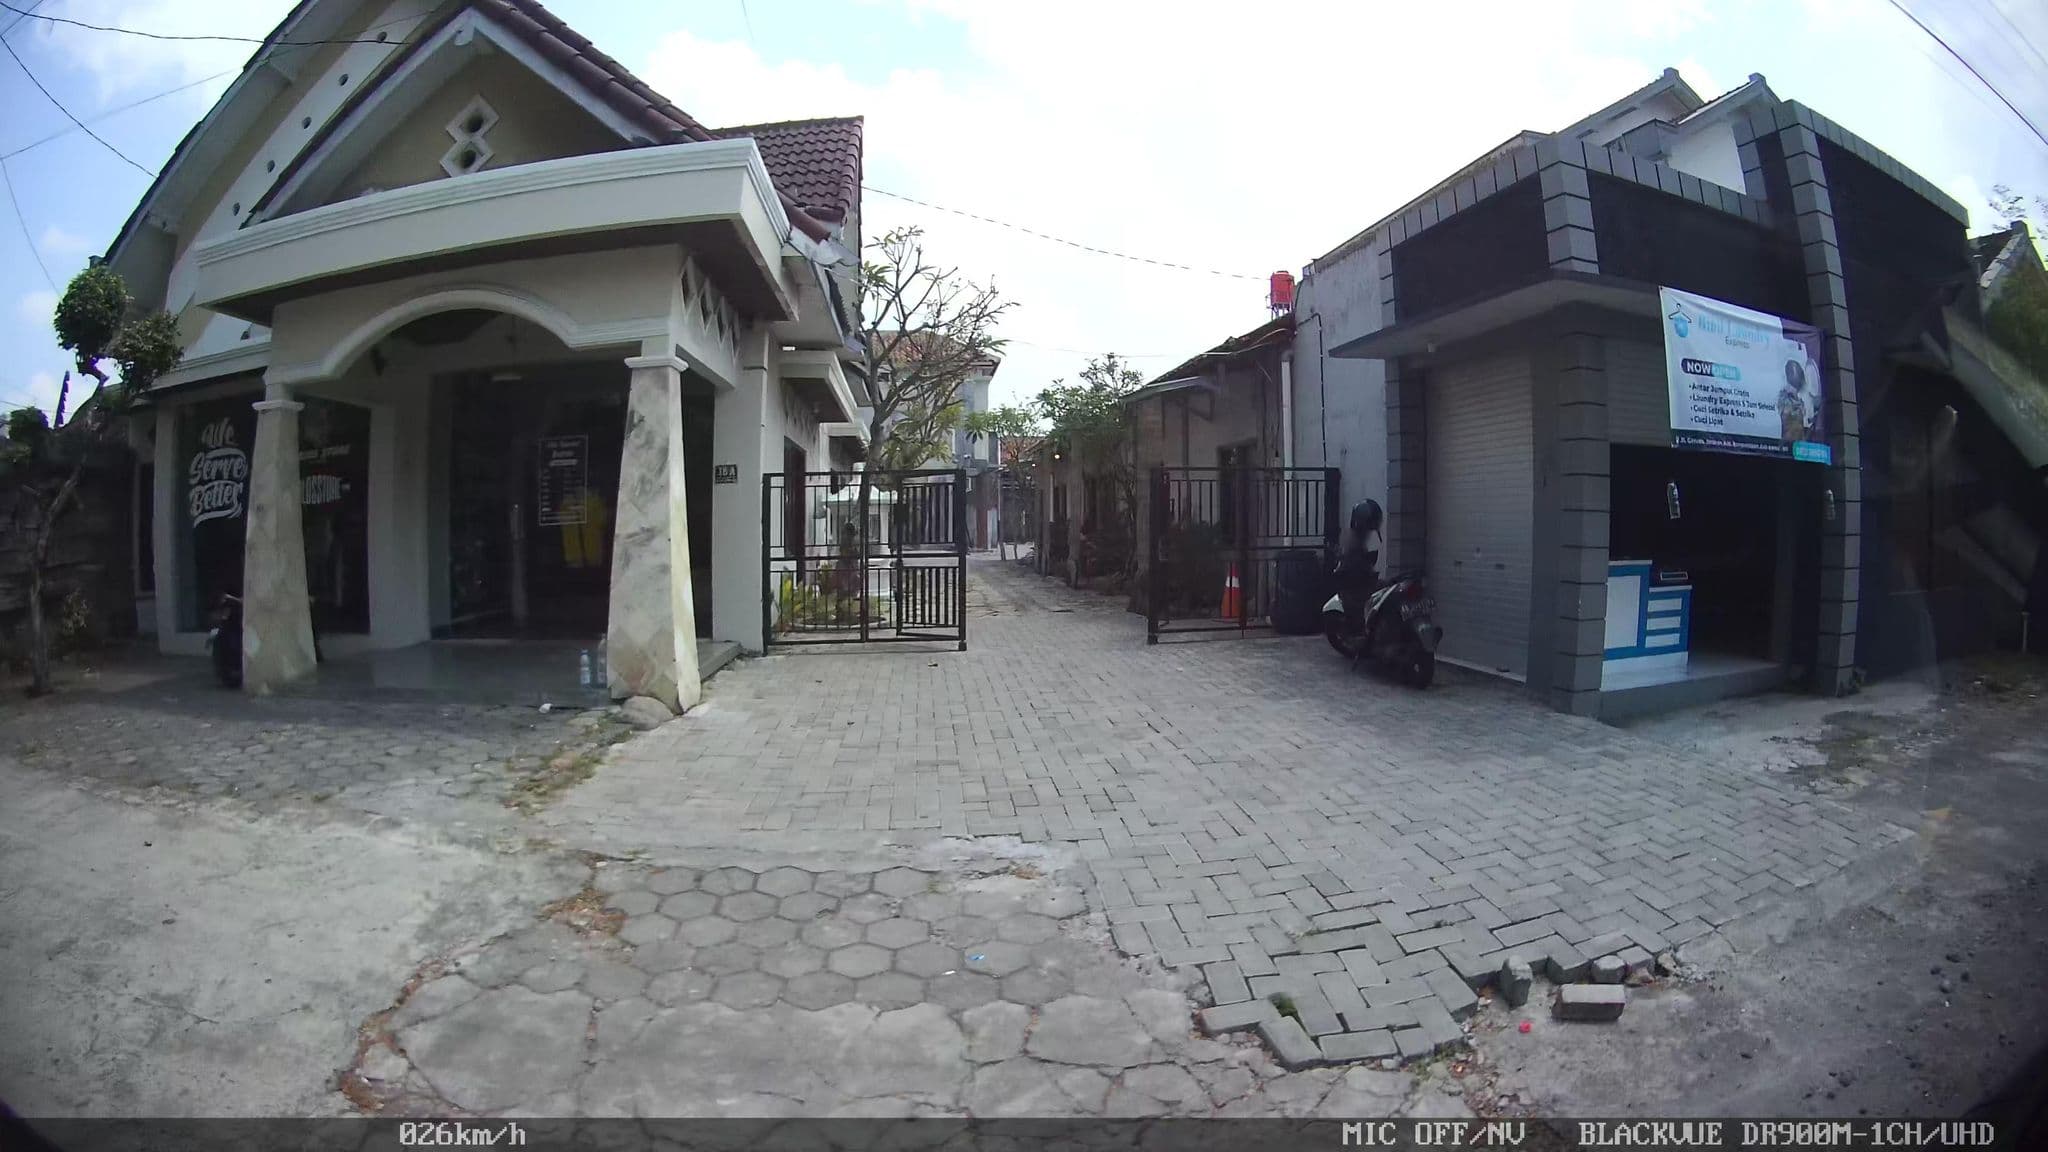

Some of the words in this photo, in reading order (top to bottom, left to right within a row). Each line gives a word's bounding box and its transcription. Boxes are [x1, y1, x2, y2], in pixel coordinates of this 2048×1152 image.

[1686, 360, 1711, 375] NOW
[1712, 364, 1736, 379] OPEN
[1693, 393, 1718, 405] Laundry
[202, 417, 239, 448] We
[188, 449, 248, 485] Serve
[188, 481, 243, 518] Better
